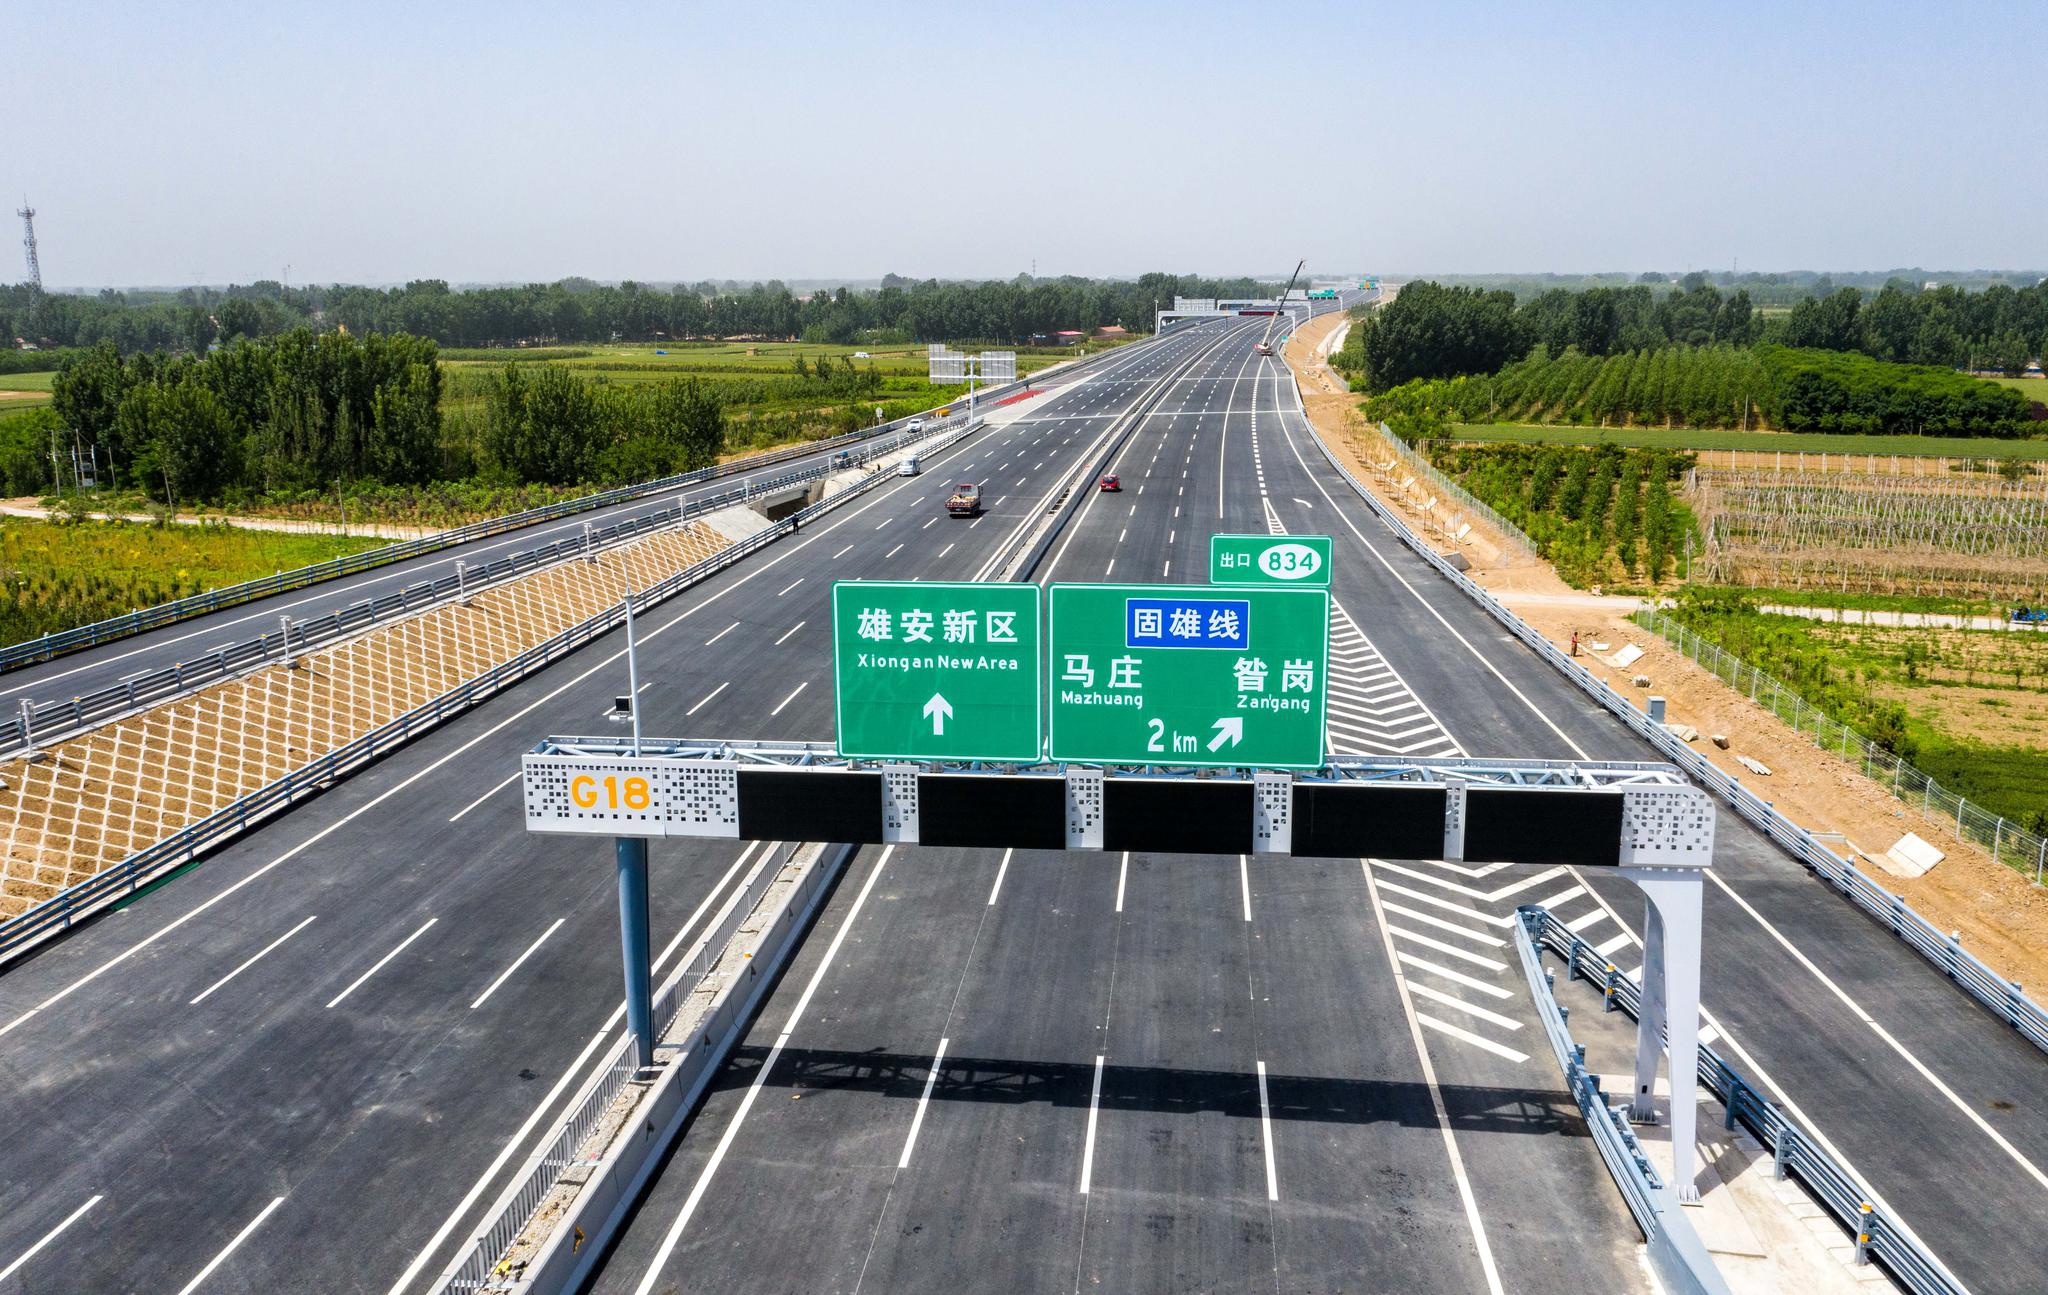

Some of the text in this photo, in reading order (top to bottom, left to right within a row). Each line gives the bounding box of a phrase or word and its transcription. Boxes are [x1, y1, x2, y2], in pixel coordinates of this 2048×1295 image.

[1220, 551, 1314, 571] 出口 834
[857, 607, 1019, 644] 雄安新区
[1134, 608, 1240, 641] 固雄线
[857, 653, 1019, 673] Xiongan New Area
[1061, 654, 1143, 689] 马庄
[1232, 656, 1314, 694] 昝岗
[1061, 690, 1144, 710] Mazhuang
[1147, 717, 1197, 753] 2 km
[571, 775, 650, 810] G18
